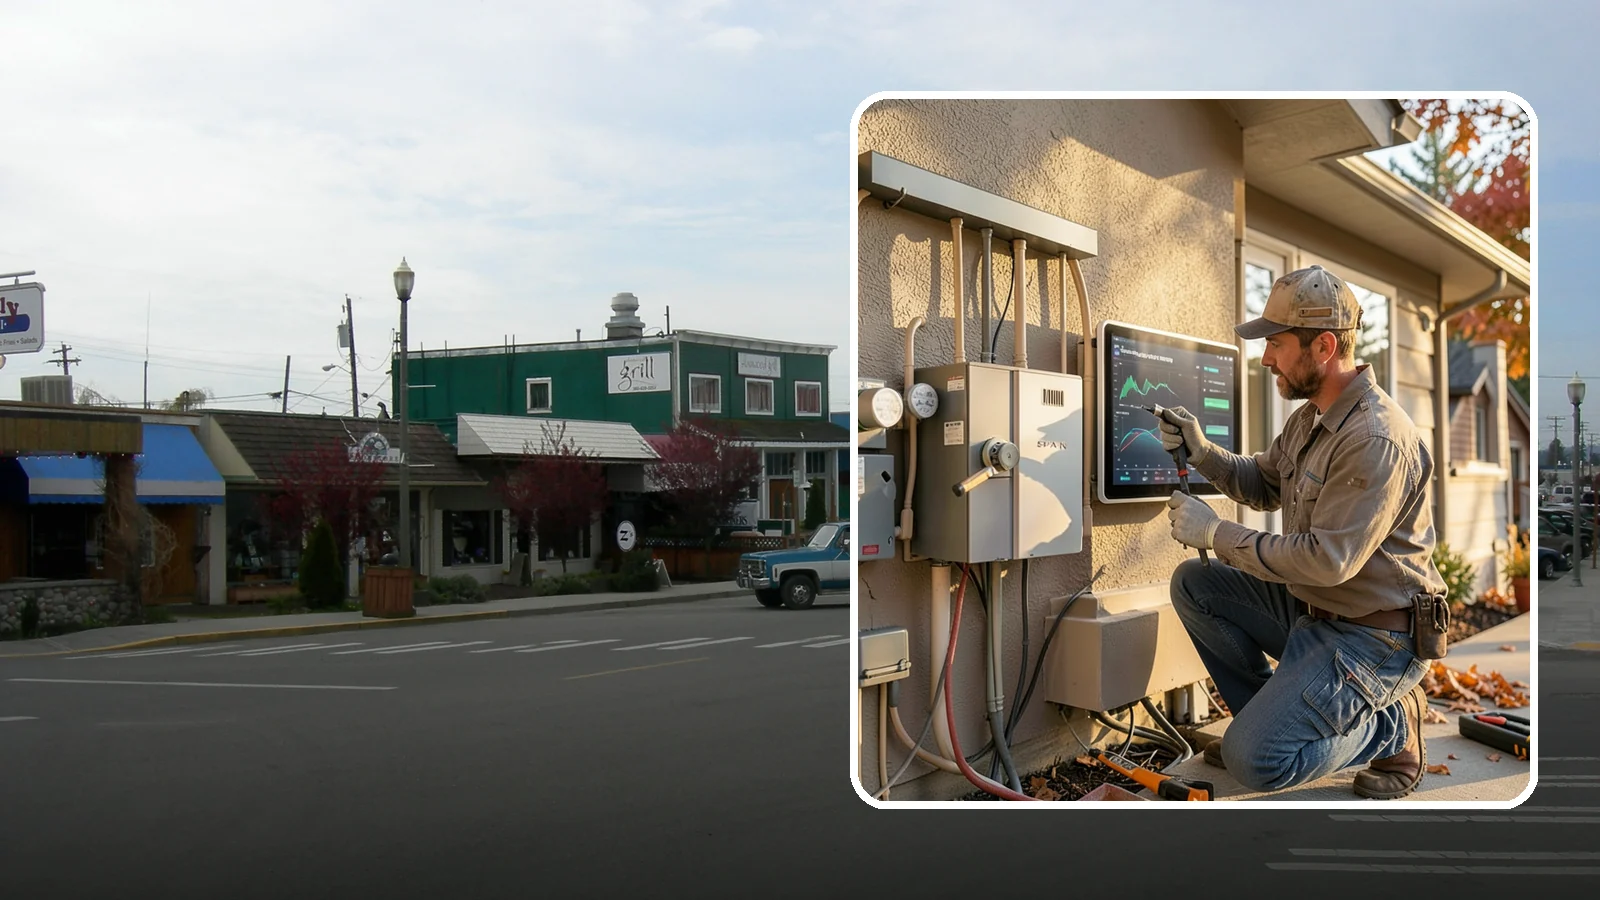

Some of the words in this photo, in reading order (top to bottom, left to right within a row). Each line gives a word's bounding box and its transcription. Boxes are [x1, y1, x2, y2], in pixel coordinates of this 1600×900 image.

[20, 337, 38, 345] Salads
[618, 356, 654, 391] grill
[1037, 440, 1067, 450] SPAN
